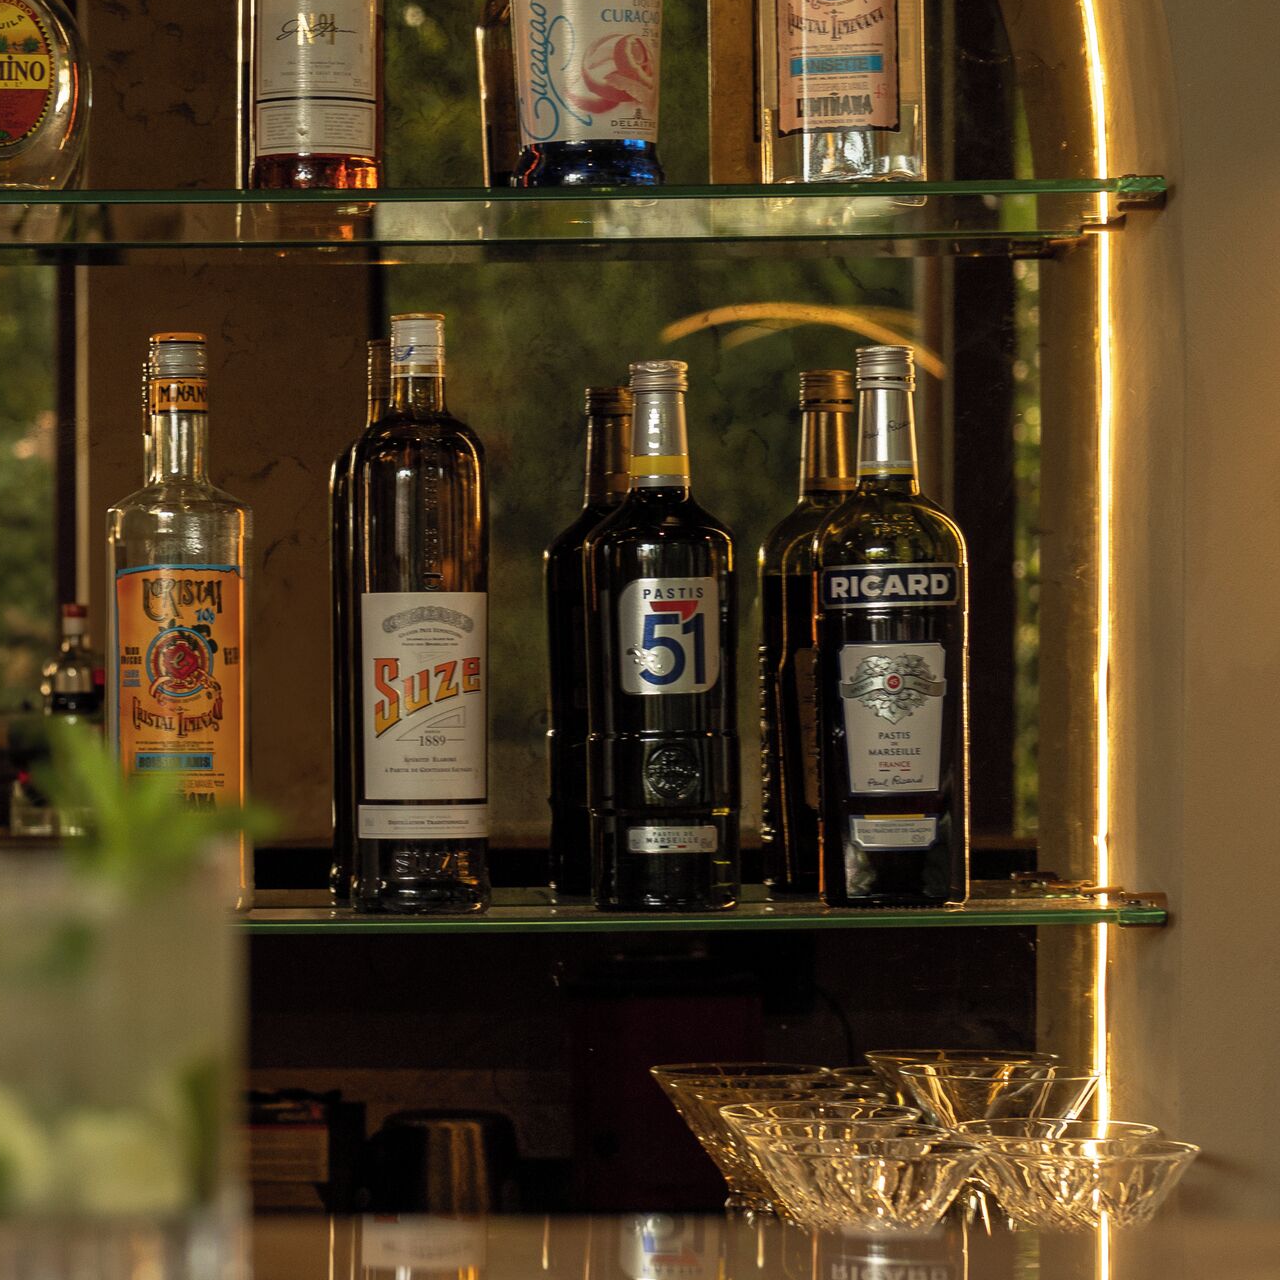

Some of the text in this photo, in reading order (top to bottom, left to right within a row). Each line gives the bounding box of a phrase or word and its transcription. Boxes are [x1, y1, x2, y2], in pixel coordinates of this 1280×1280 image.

[610, 120, 657, 130] DELAITRE
[831, 573, 950, 599] RICARD
[142, 578, 223, 621] CRISTAL
[643, 587, 705, 600] PASTIS
[639, 612, 707, 686] 51
[374, 657, 481, 739] Suze
[419, 735, 447, 747] 1889
[878, 731, 911, 740] PASTIS
[868, 747, 921, 756] MARSEILLE
